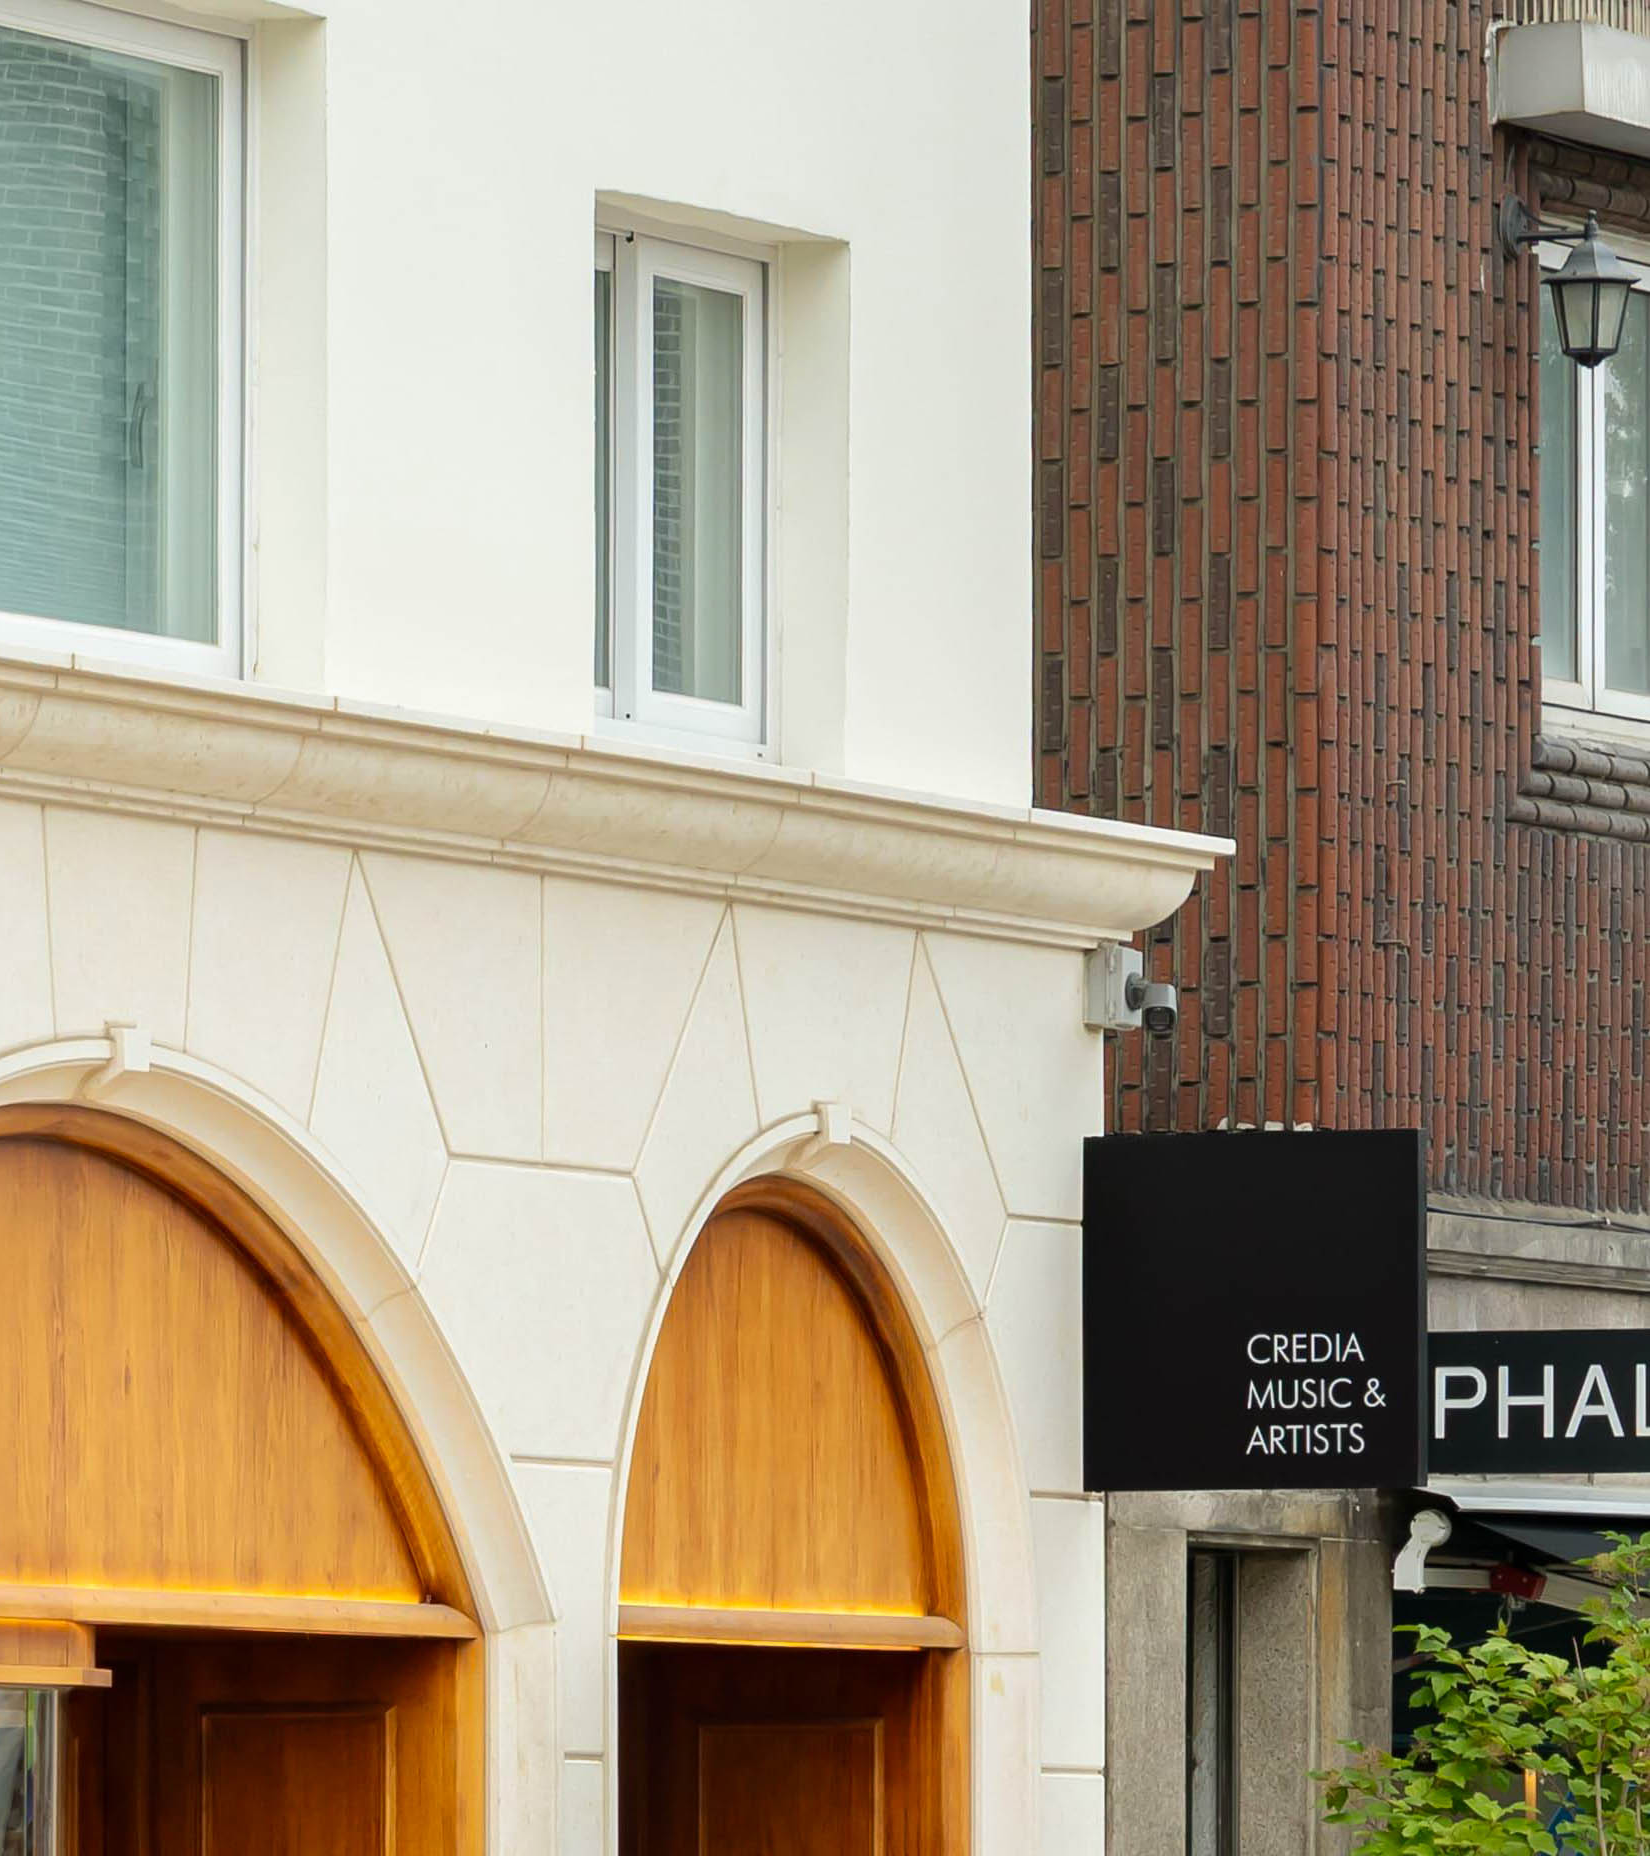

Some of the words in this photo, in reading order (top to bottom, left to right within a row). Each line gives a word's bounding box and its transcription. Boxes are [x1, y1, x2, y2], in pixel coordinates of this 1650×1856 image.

[1246, 1332, 1365, 1365] CREDIA
[1247, 1377, 1353, 1410] MUSIC
[1363, 1377, 1387, 1408] &
[1245, 1422, 1365, 1455] ARTISTS
